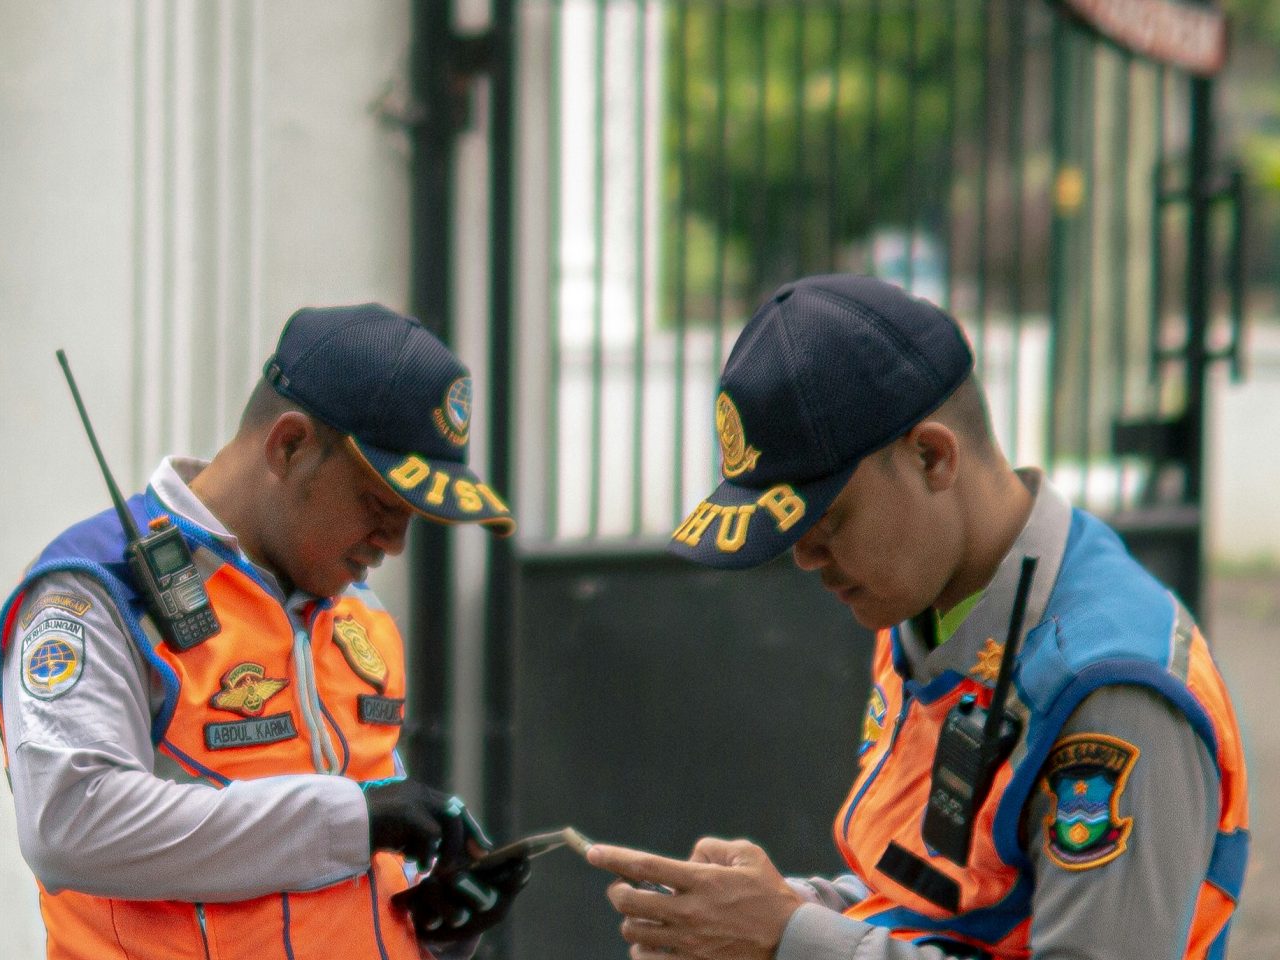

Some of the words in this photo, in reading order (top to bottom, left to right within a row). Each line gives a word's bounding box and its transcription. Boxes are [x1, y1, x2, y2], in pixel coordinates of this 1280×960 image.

[672, 484, 807, 553] HUB
[25, 620, 82, 644] PERHUBUNGAN
[213, 724, 253, 744] ABDUL
[255, 719, 290, 738] KARIM
